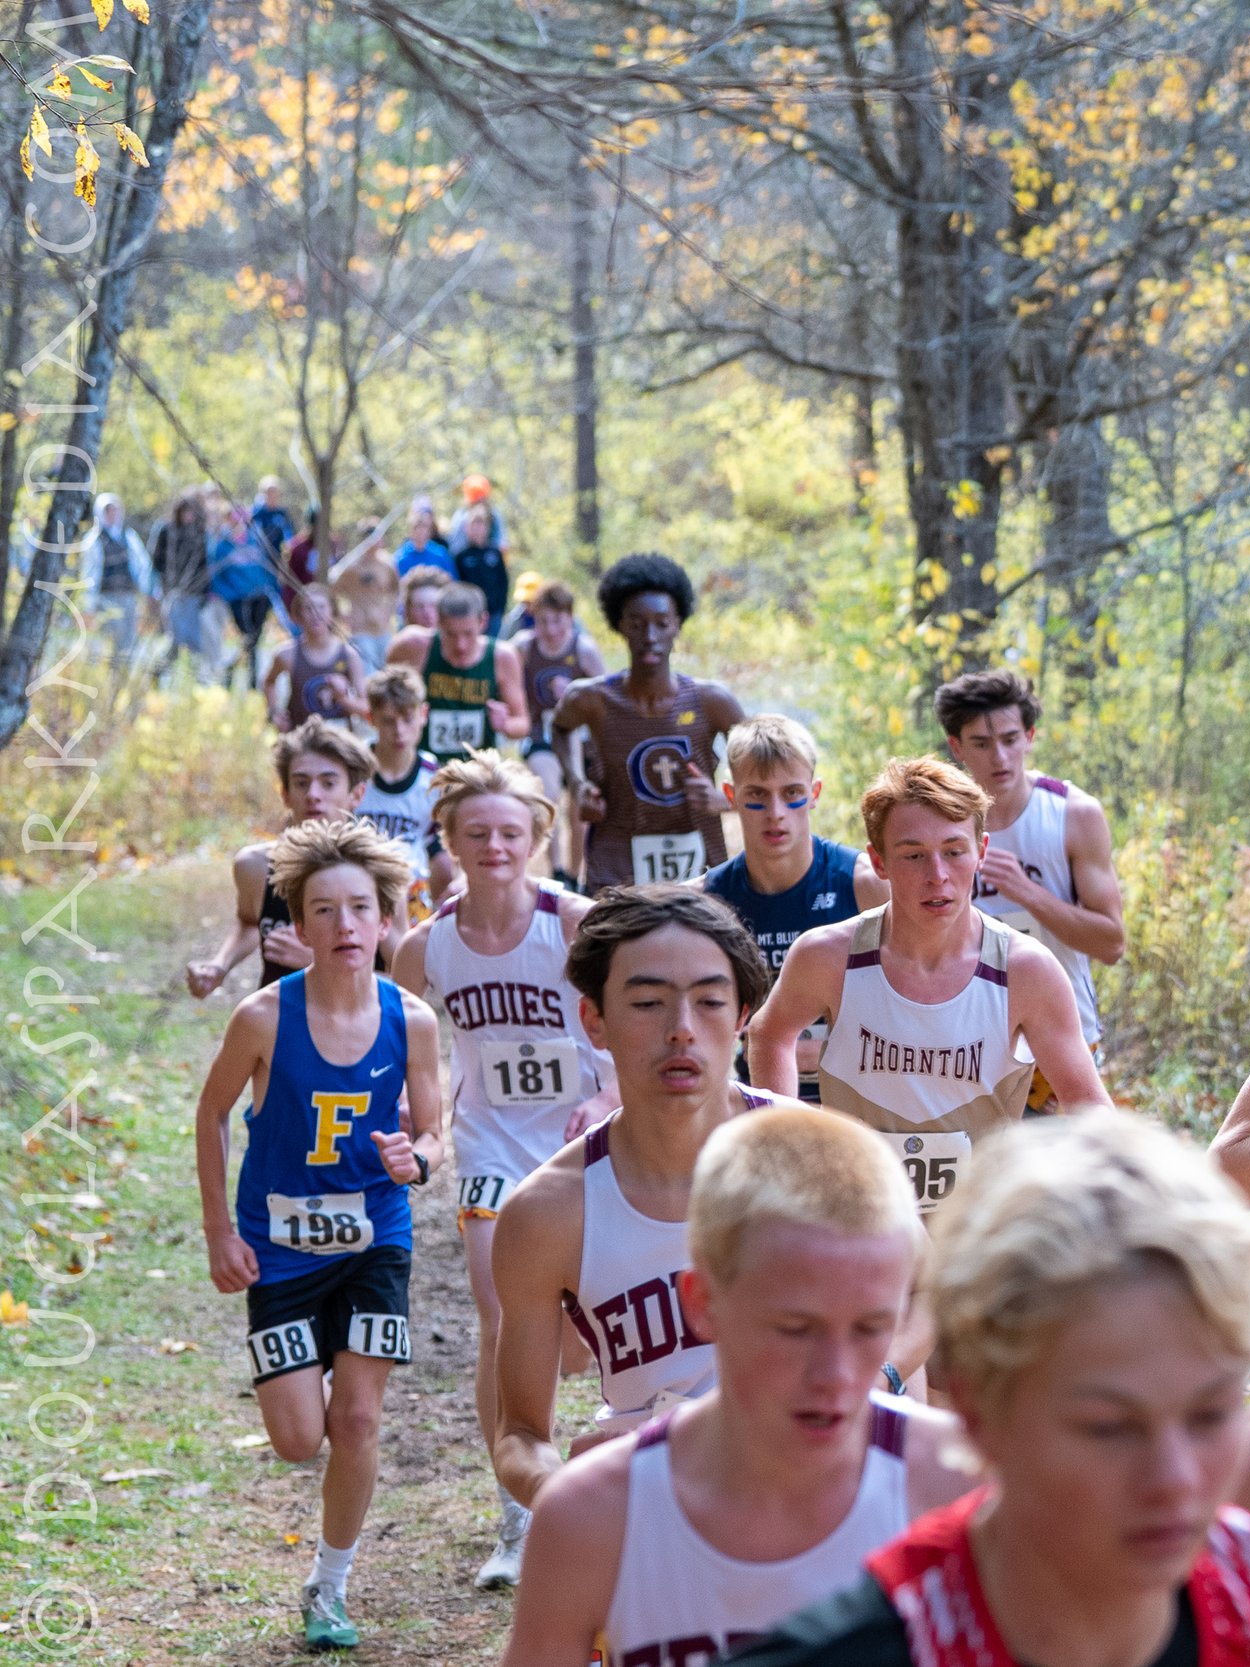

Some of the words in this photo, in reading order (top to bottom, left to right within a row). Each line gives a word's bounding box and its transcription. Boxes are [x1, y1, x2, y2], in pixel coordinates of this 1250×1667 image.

[642, 850, 696, 885] 157
[757, 932, 774, 946] MT.
[444, 981, 565, 1031] EDDIES
[858, 1023, 985, 1084] THORNTON
[493, 1058, 563, 1095] 181
[306, 1091, 372, 1166] F
[283, 1213, 362, 1246] 198
[360, 1317, 407, 1357] 198
